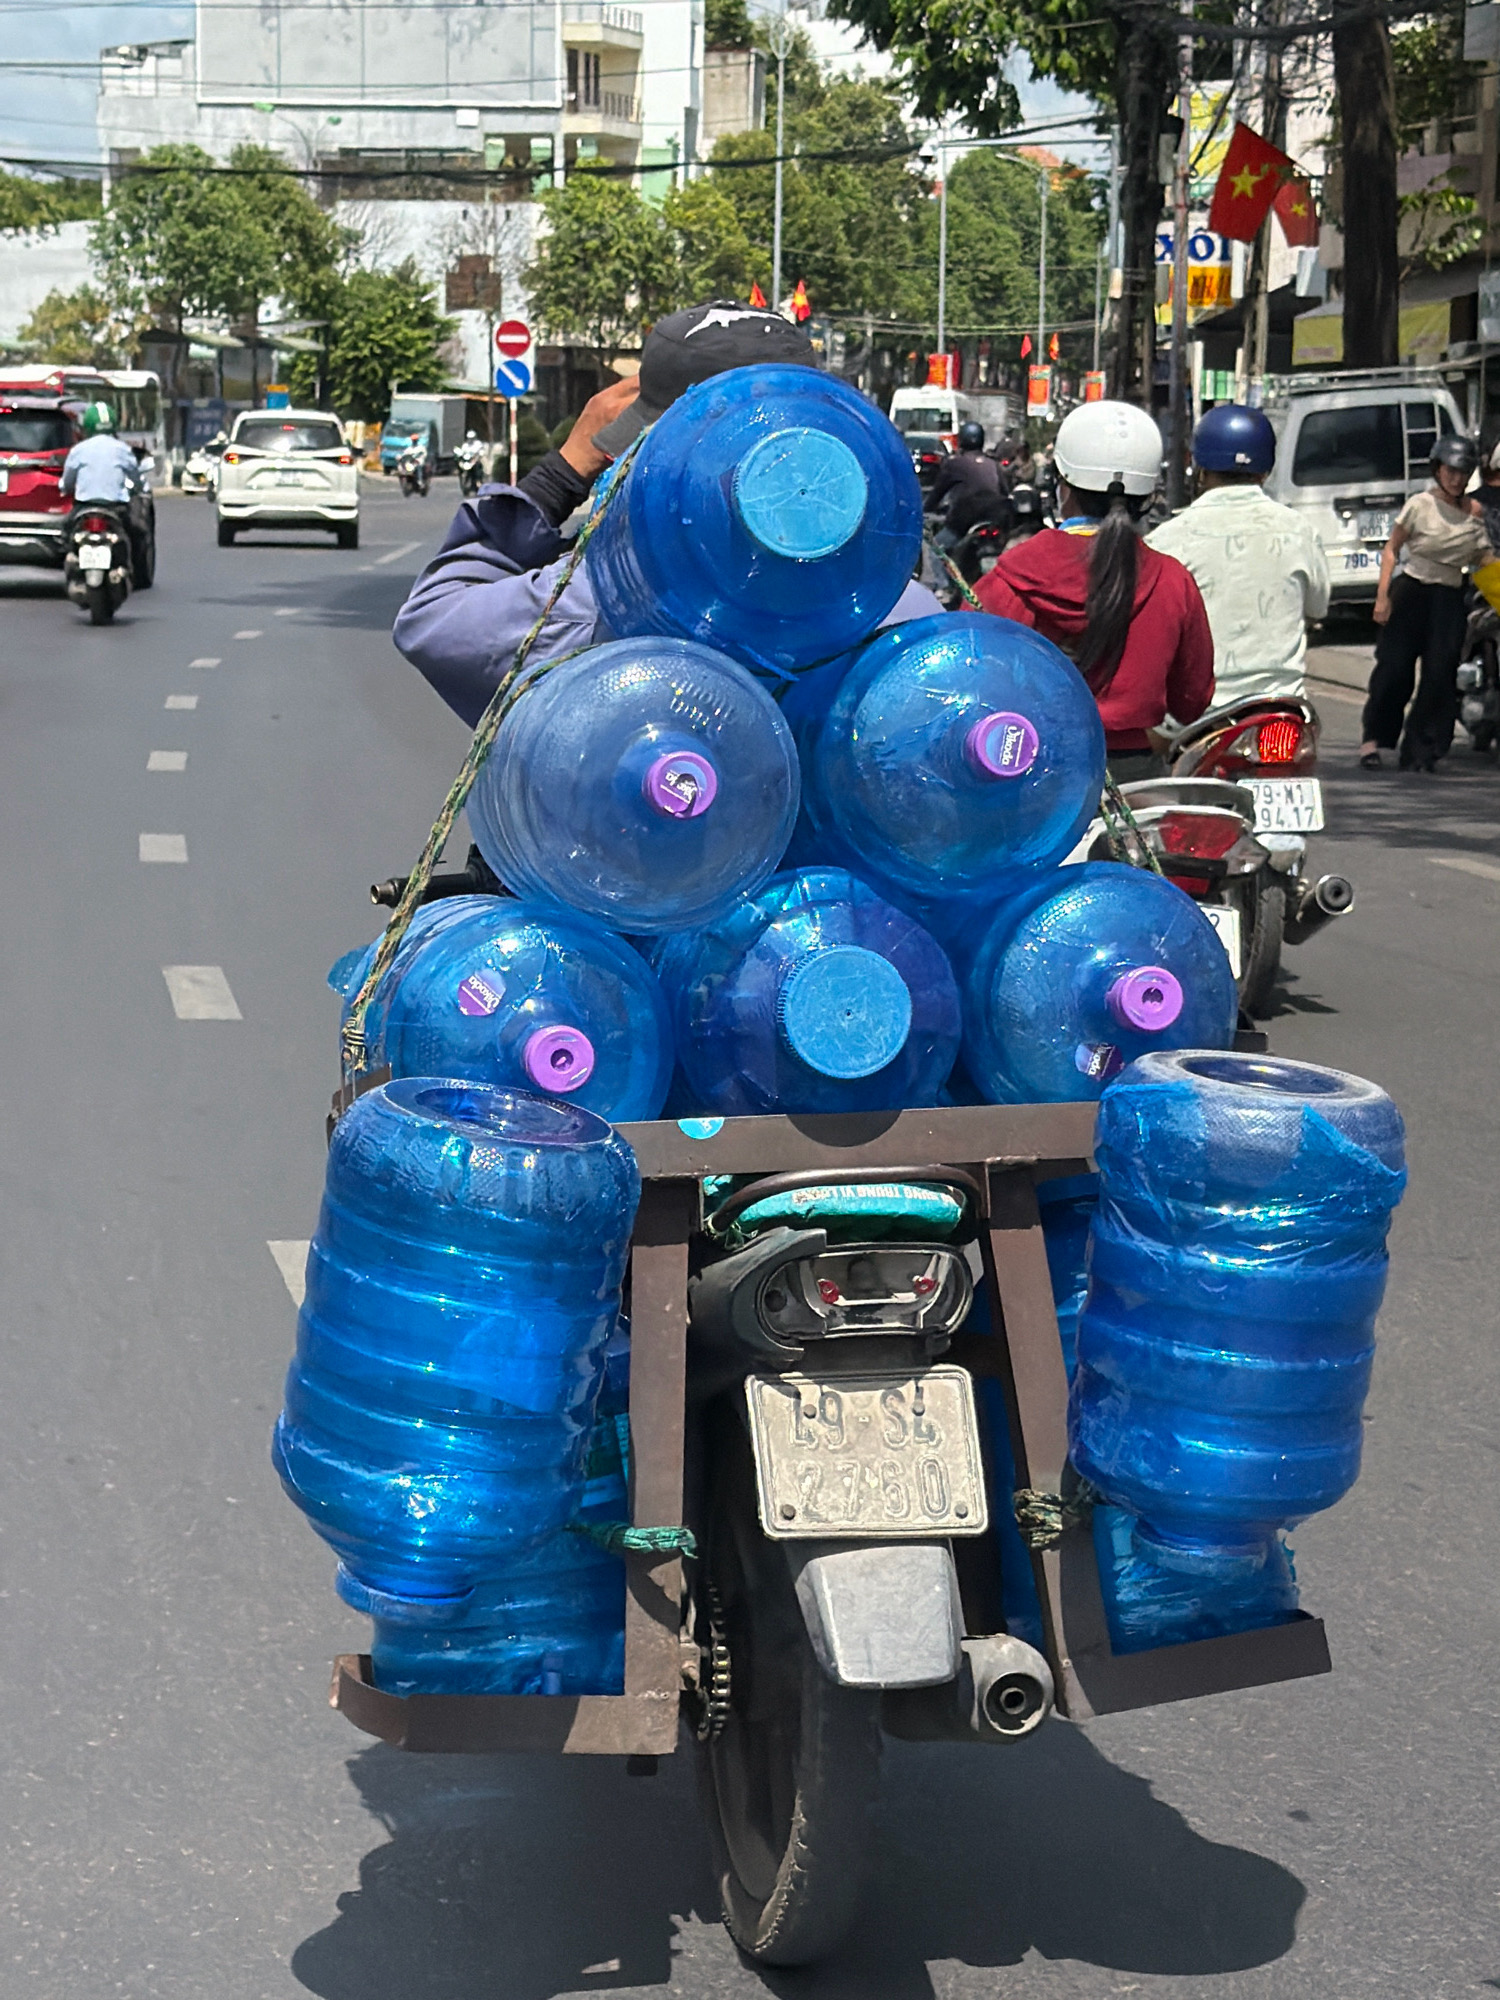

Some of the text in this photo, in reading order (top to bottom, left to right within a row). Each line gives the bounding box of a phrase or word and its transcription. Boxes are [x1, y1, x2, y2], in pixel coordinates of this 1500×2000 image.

[1344, 552, 1383, 570] 79D-0
[1261, 806, 1316, 829] 94.17
[856, 1184, 901, 1199] TRUNG
